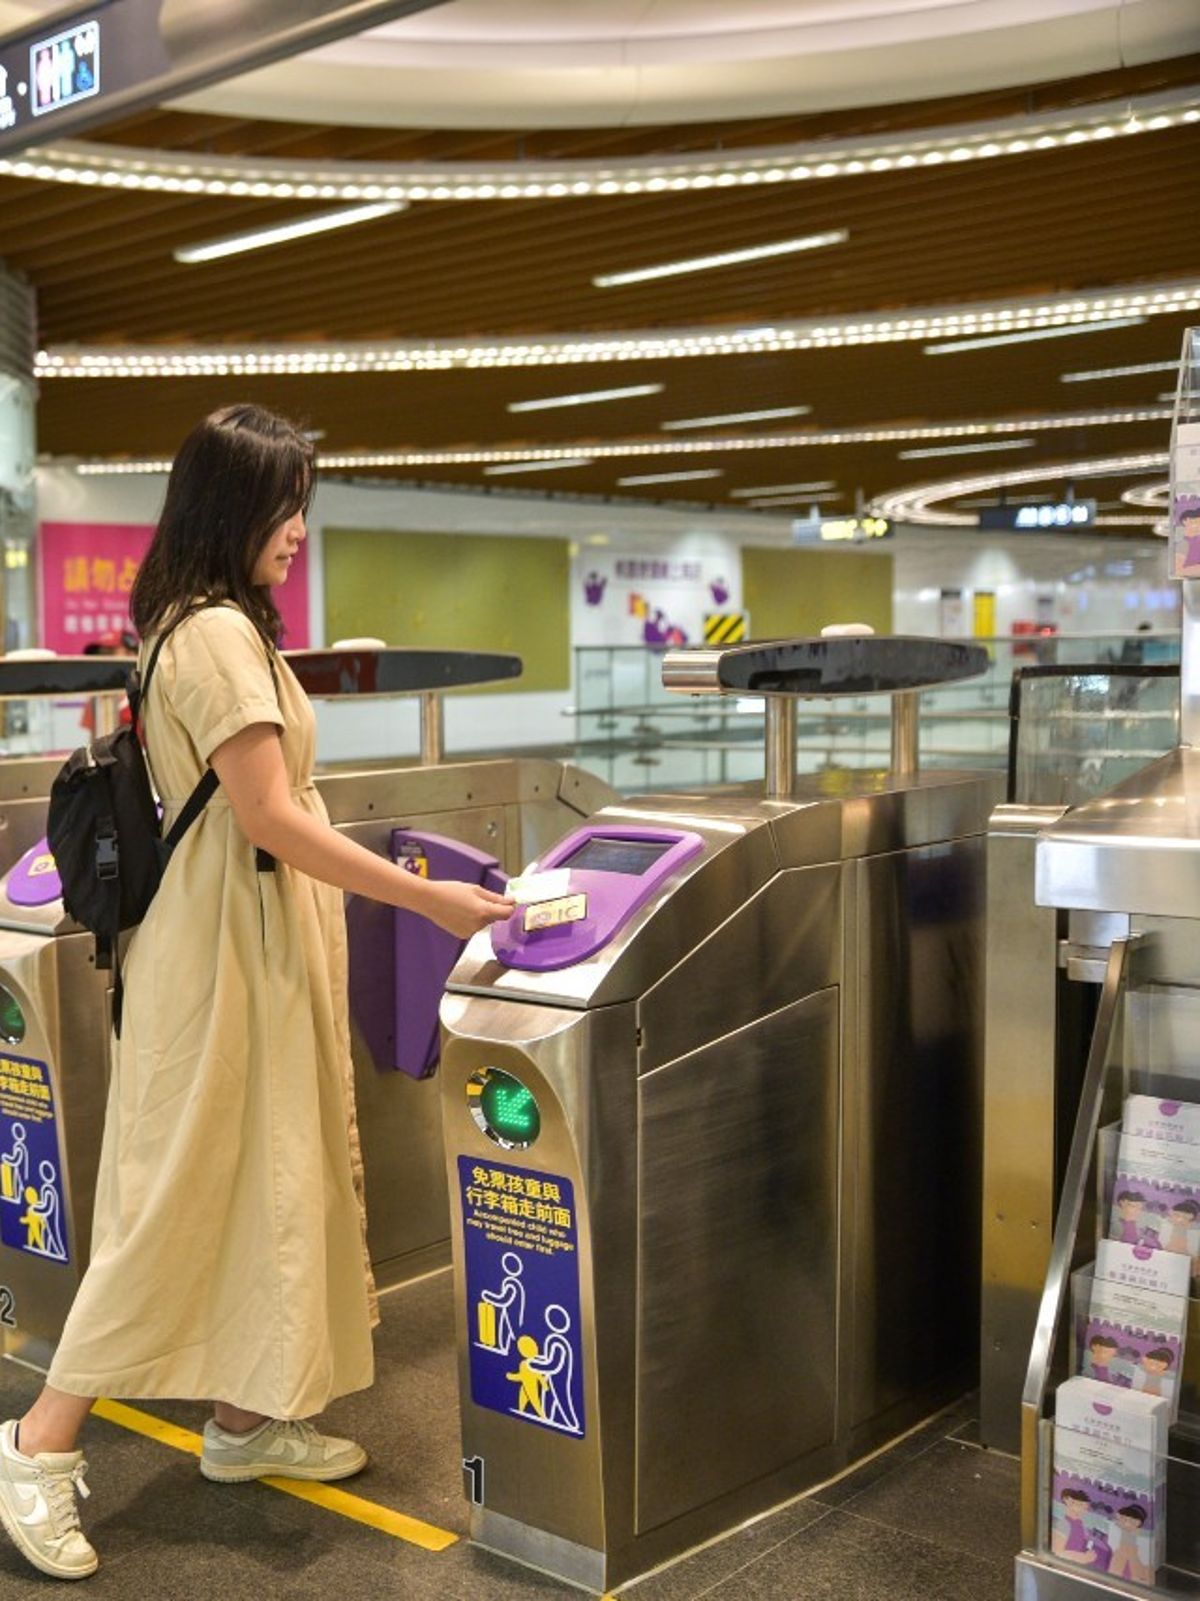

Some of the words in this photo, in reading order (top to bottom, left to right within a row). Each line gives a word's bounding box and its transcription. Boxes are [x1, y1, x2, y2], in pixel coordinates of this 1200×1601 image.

[472, 1166, 560, 1203] 免票孩童與
[466, 1186, 571, 1228] 行李箱走前面
[463, 1456, 484, 1505] 1
